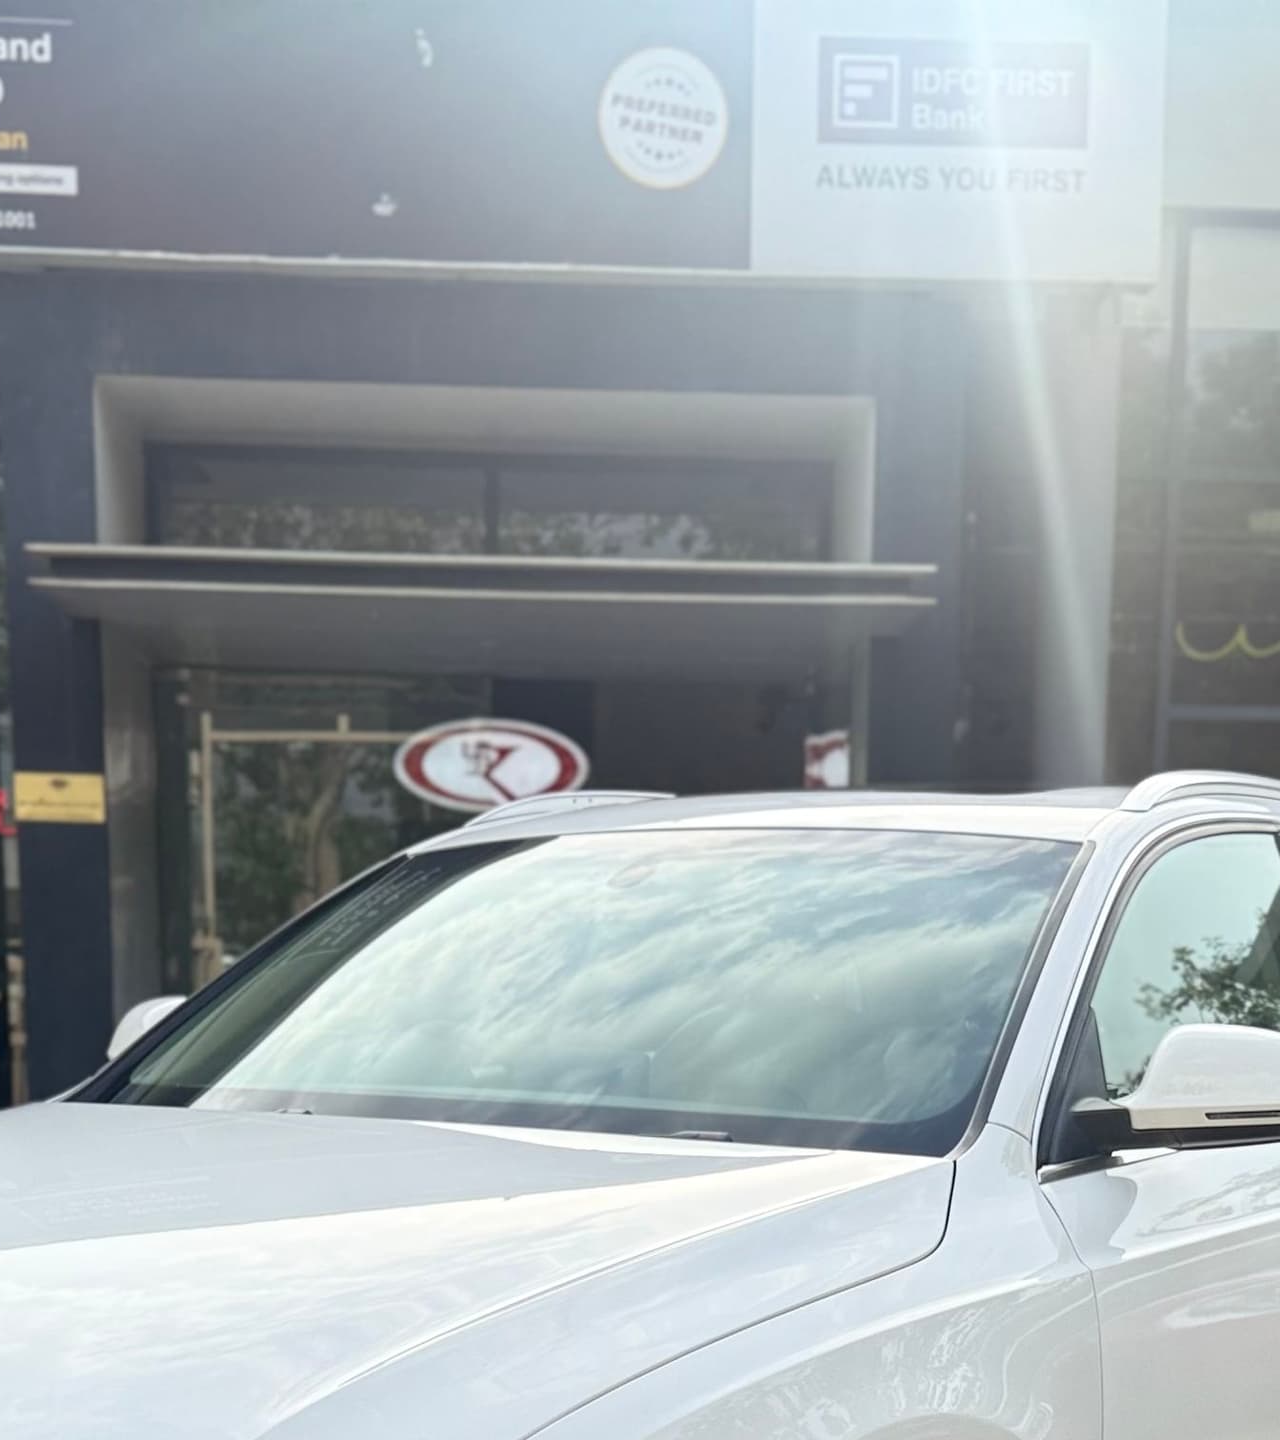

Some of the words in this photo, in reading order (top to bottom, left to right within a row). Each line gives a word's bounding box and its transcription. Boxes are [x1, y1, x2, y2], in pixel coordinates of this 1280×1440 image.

[912, 66, 983, 97] IDFC
[989, 68, 1074, 98] FIRST
[611, 93, 717, 127] PREFERRED
[912, 103, 987, 130] Bank
[619, 115, 705, 144] PARTNER
[816, 163, 930, 190] ALWAYS
[939, 166, 997, 192] YOU
[1007, 167, 1088, 194] FIRST
